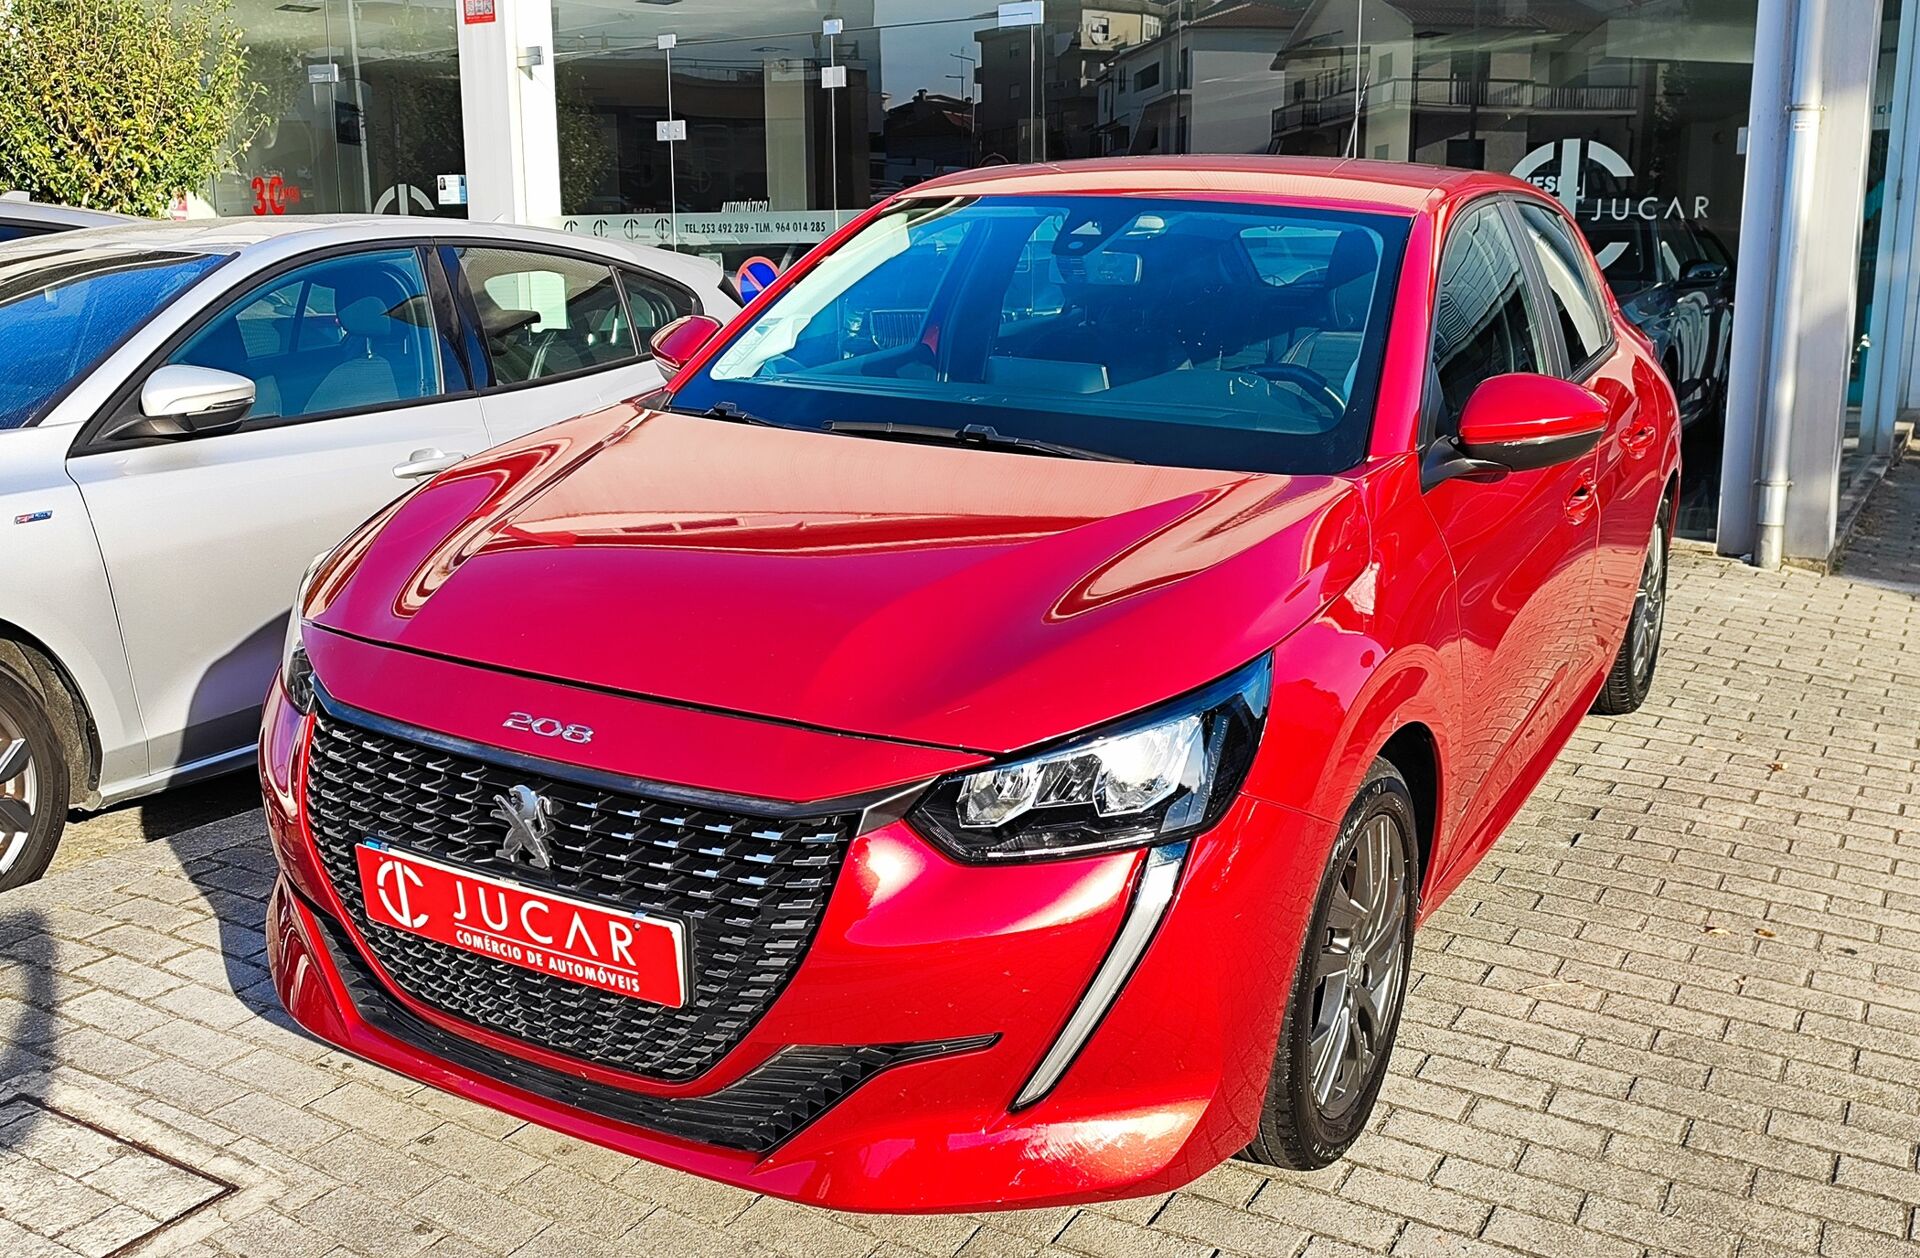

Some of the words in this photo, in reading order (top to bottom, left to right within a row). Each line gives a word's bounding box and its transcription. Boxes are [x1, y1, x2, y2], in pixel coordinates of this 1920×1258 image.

[721, 197, 768, 213] AUTOMÁTICO
[1591, 195, 1710, 222] JUCAR
[685, 223, 700, 234] TEL.
[701, 223, 716, 234] 253
[718, 222, 733, 234] 492
[734, 222, 749, 234] 289
[755, 222, 774, 233] TLM.
[775, 222, 791, 233] 964
[792, 222, 808, 233] 014
[810, 221, 826, 232] 285
[502, 711, 594, 744] 208
[453, 880, 637, 967] JUCAR
[455, 929, 522, 961] COMÉRCIO
[526, 949, 544, 967] DE
[548, 956, 640, 993] AUTOMÓVEIS
